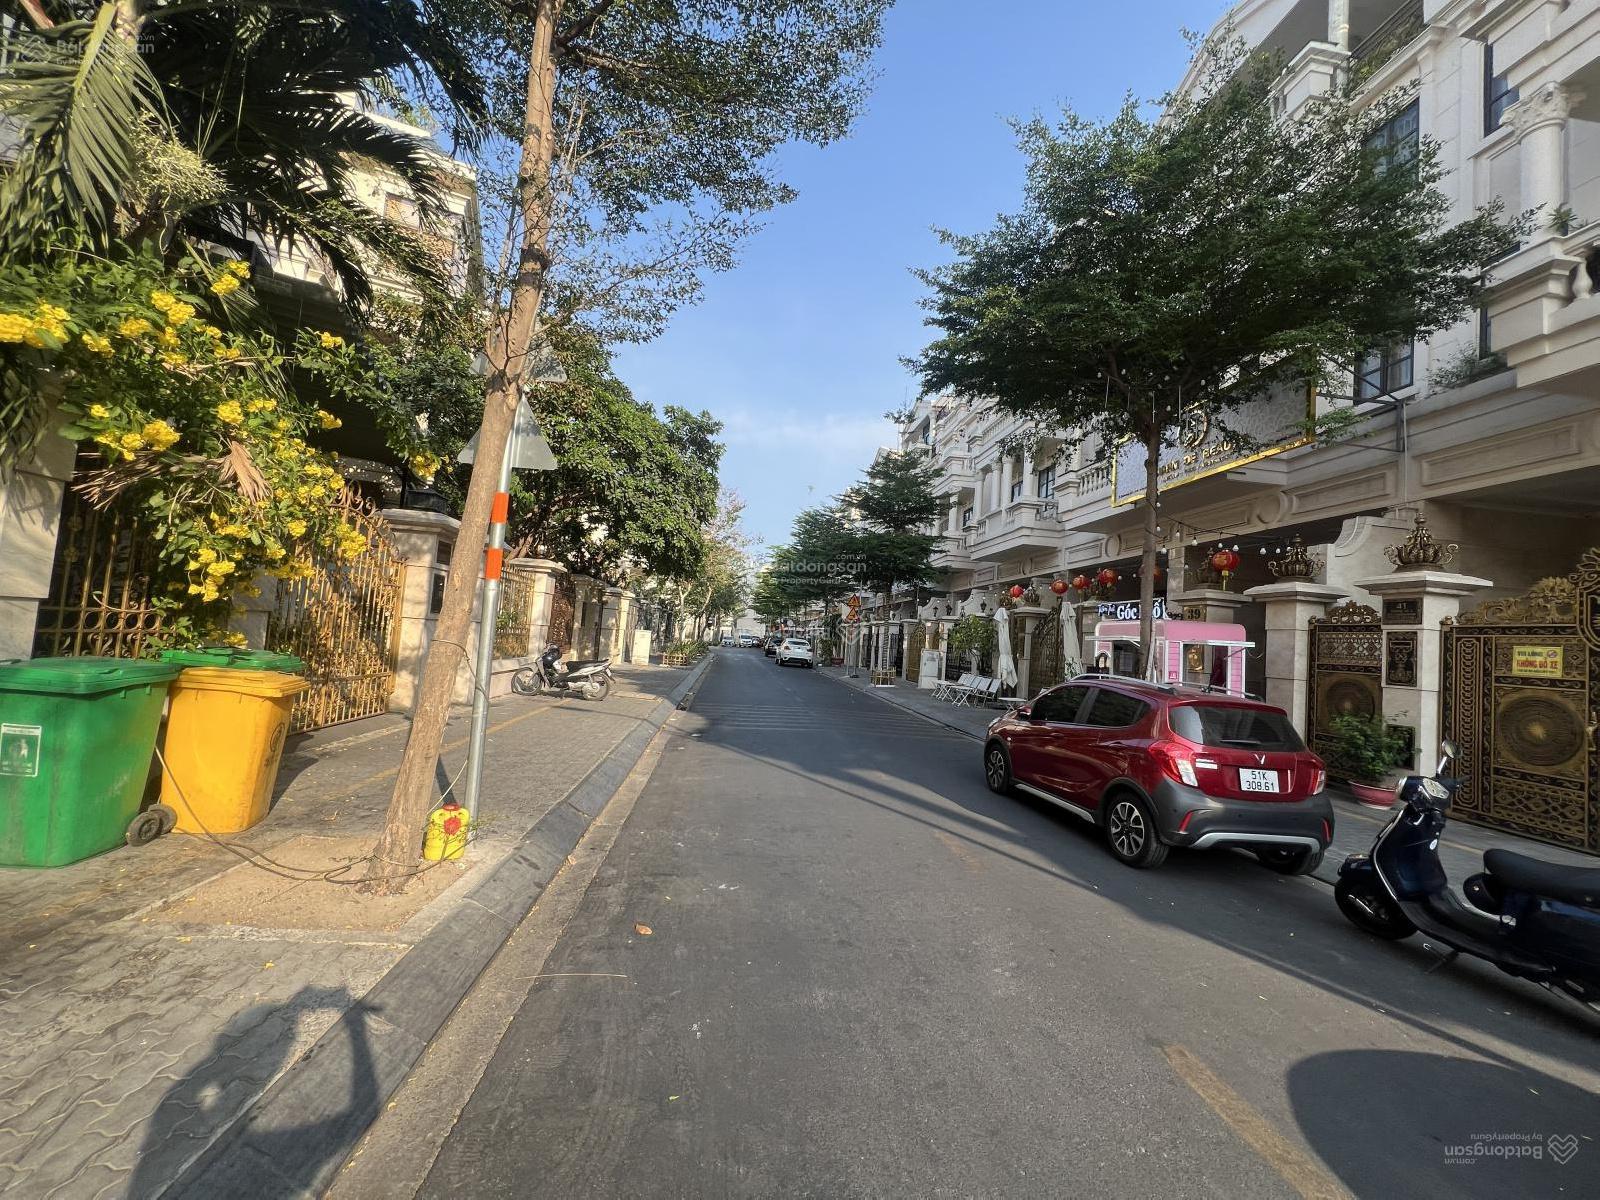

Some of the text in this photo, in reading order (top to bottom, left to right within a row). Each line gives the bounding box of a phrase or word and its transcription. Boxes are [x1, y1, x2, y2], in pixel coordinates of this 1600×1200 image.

[1116, 603, 1137, 620] Góc
[1188, 608, 1201, 620] 39
[1251, 770, 1267, 781] 51K
[1246, 780, 1275, 791] 308.61
